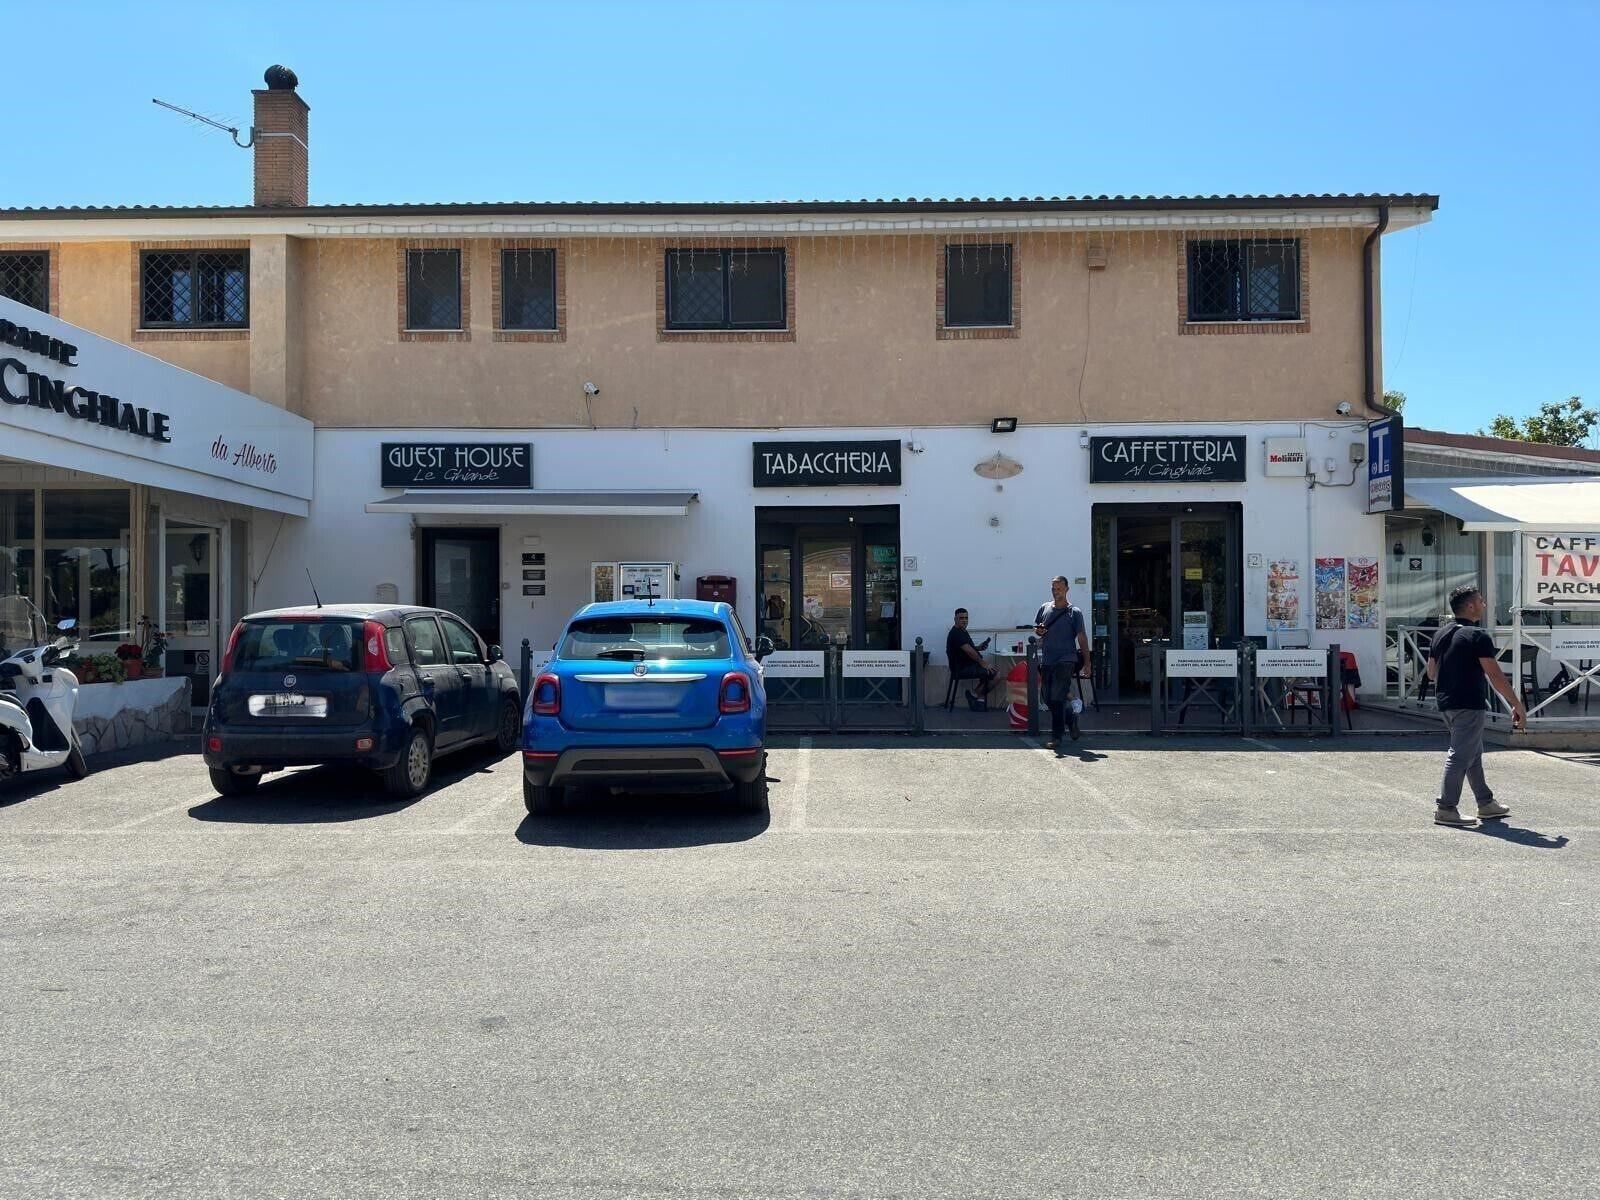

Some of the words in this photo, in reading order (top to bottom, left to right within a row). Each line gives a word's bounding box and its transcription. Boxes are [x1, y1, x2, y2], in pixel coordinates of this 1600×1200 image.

[0, 358, 171, 443] CINGHIALE
[211, 434, 228, 461] da
[232, 443, 278, 474] Alberto
[388, 447, 446, 468] GUEST
[454, 447, 524, 468] HOUSE
[1101, 440, 1238, 463] CAFFETTERIA
[1269, 454, 1304, 463] Molinari
[1372, 426, 1389, 474] T
[762, 451, 892, 475] TABACCHERIA
[1124, 463, 1143, 476] Al
[1148, 463, 1215, 480] Cinghiale
[413, 468, 436, 481] Le
[443, 468, 500, 482] Ghiande
[1535, 536, 1597, 551] CAFF
[1535, 553, 1600, 577] TAV
[1537, 582, 1600, 594] PARCH
